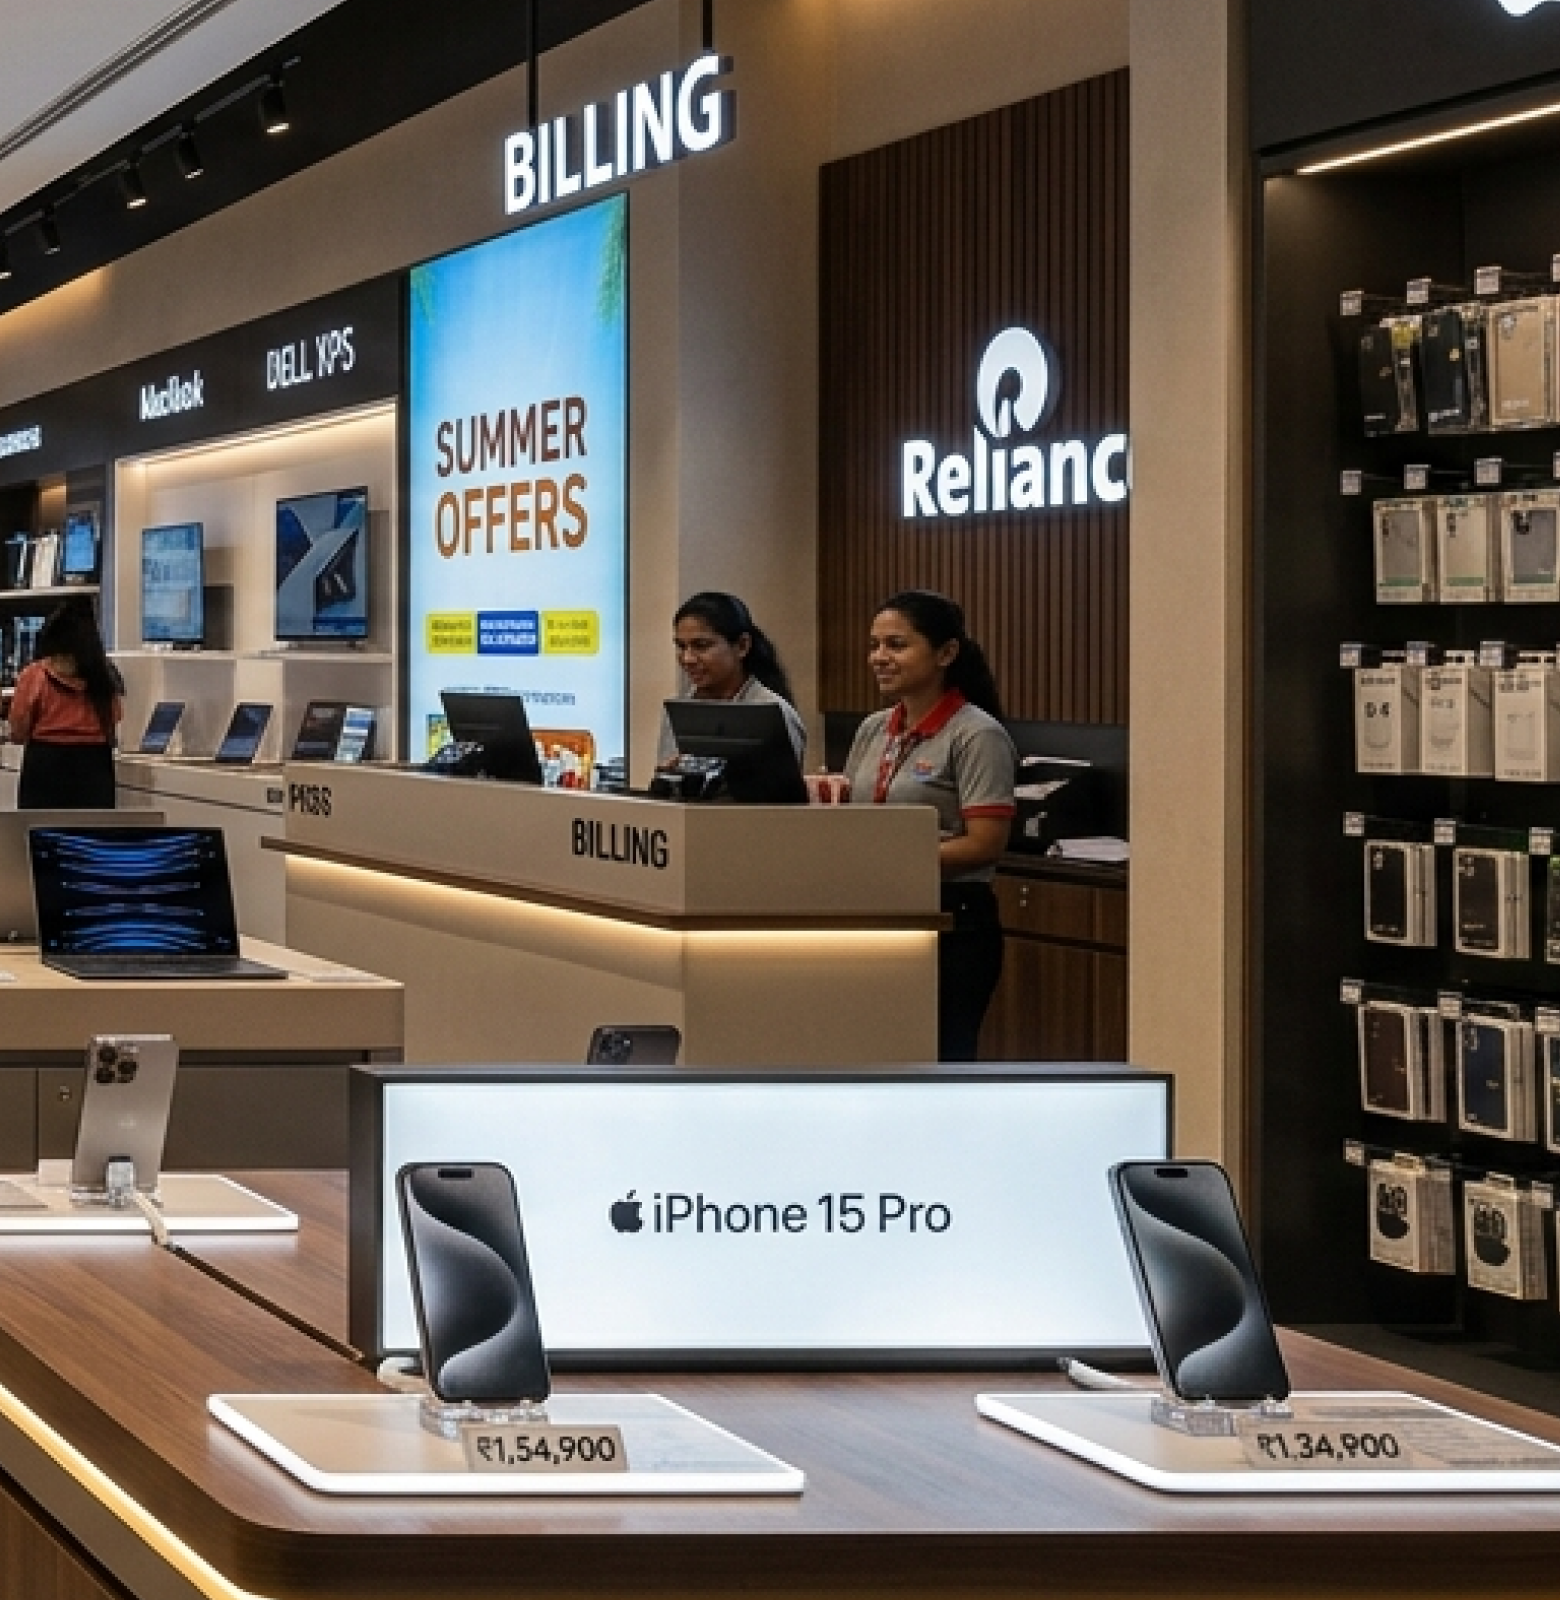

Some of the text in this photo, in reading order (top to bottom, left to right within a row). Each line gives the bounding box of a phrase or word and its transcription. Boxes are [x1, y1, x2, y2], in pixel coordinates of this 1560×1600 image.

[504, 55, 724, 215] BILLING
[266, 325, 356, 391] DELL XPS
[435, 395, 588, 478] SUMMER
[435, 473, 588, 559] OFFERS
[570, 817, 669, 870] BILLING
[653, 1191, 952, 1234] iPhone 15 Pro
[477, 1435, 617, 1466] ₹1,54,900
